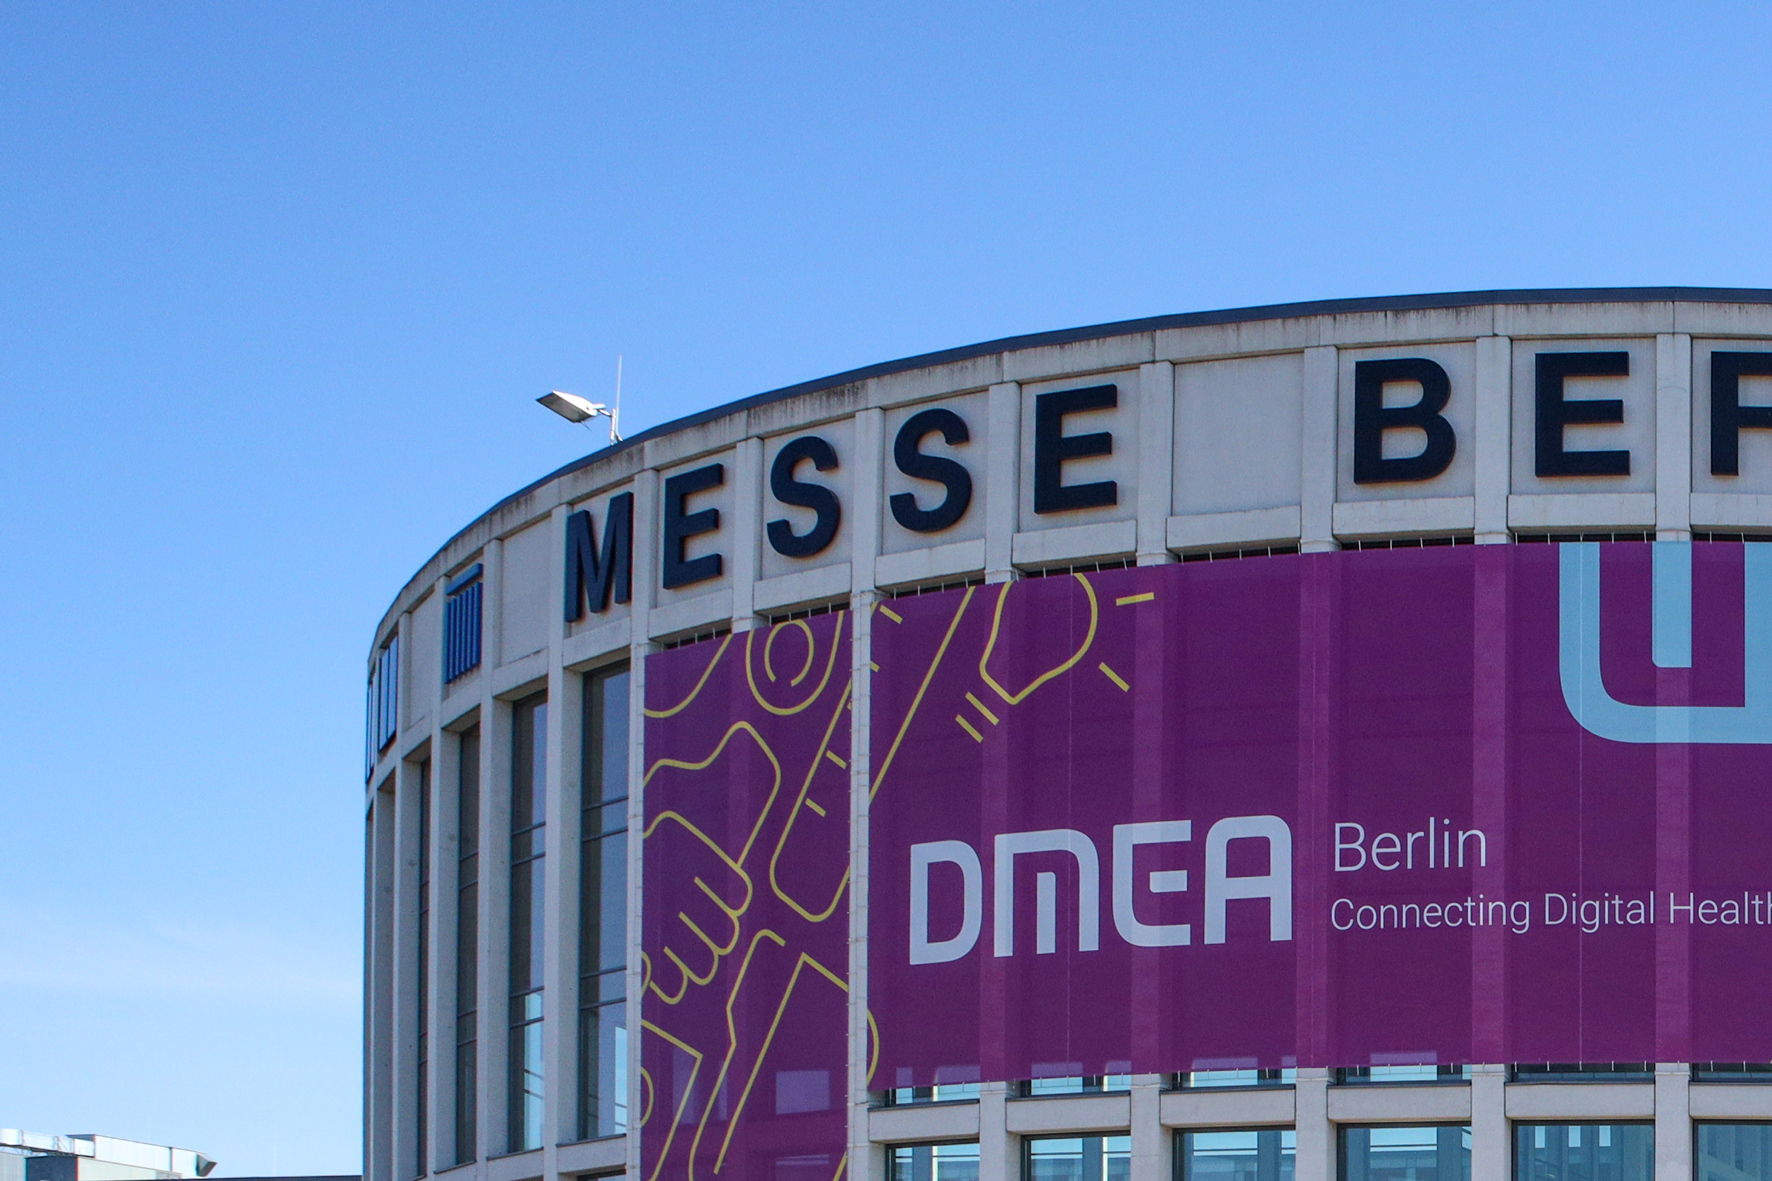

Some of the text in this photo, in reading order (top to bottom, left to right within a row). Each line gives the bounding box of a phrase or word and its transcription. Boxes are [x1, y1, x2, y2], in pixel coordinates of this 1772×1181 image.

[565, 384, 1118, 623] MESSE
[909, 814, 1292, 966] DMEA
[1334, 815, 1486, 873] Berlin
[1331, 896, 1530, 934] Connecting
[1545, 890, 1654, 934] Digital
